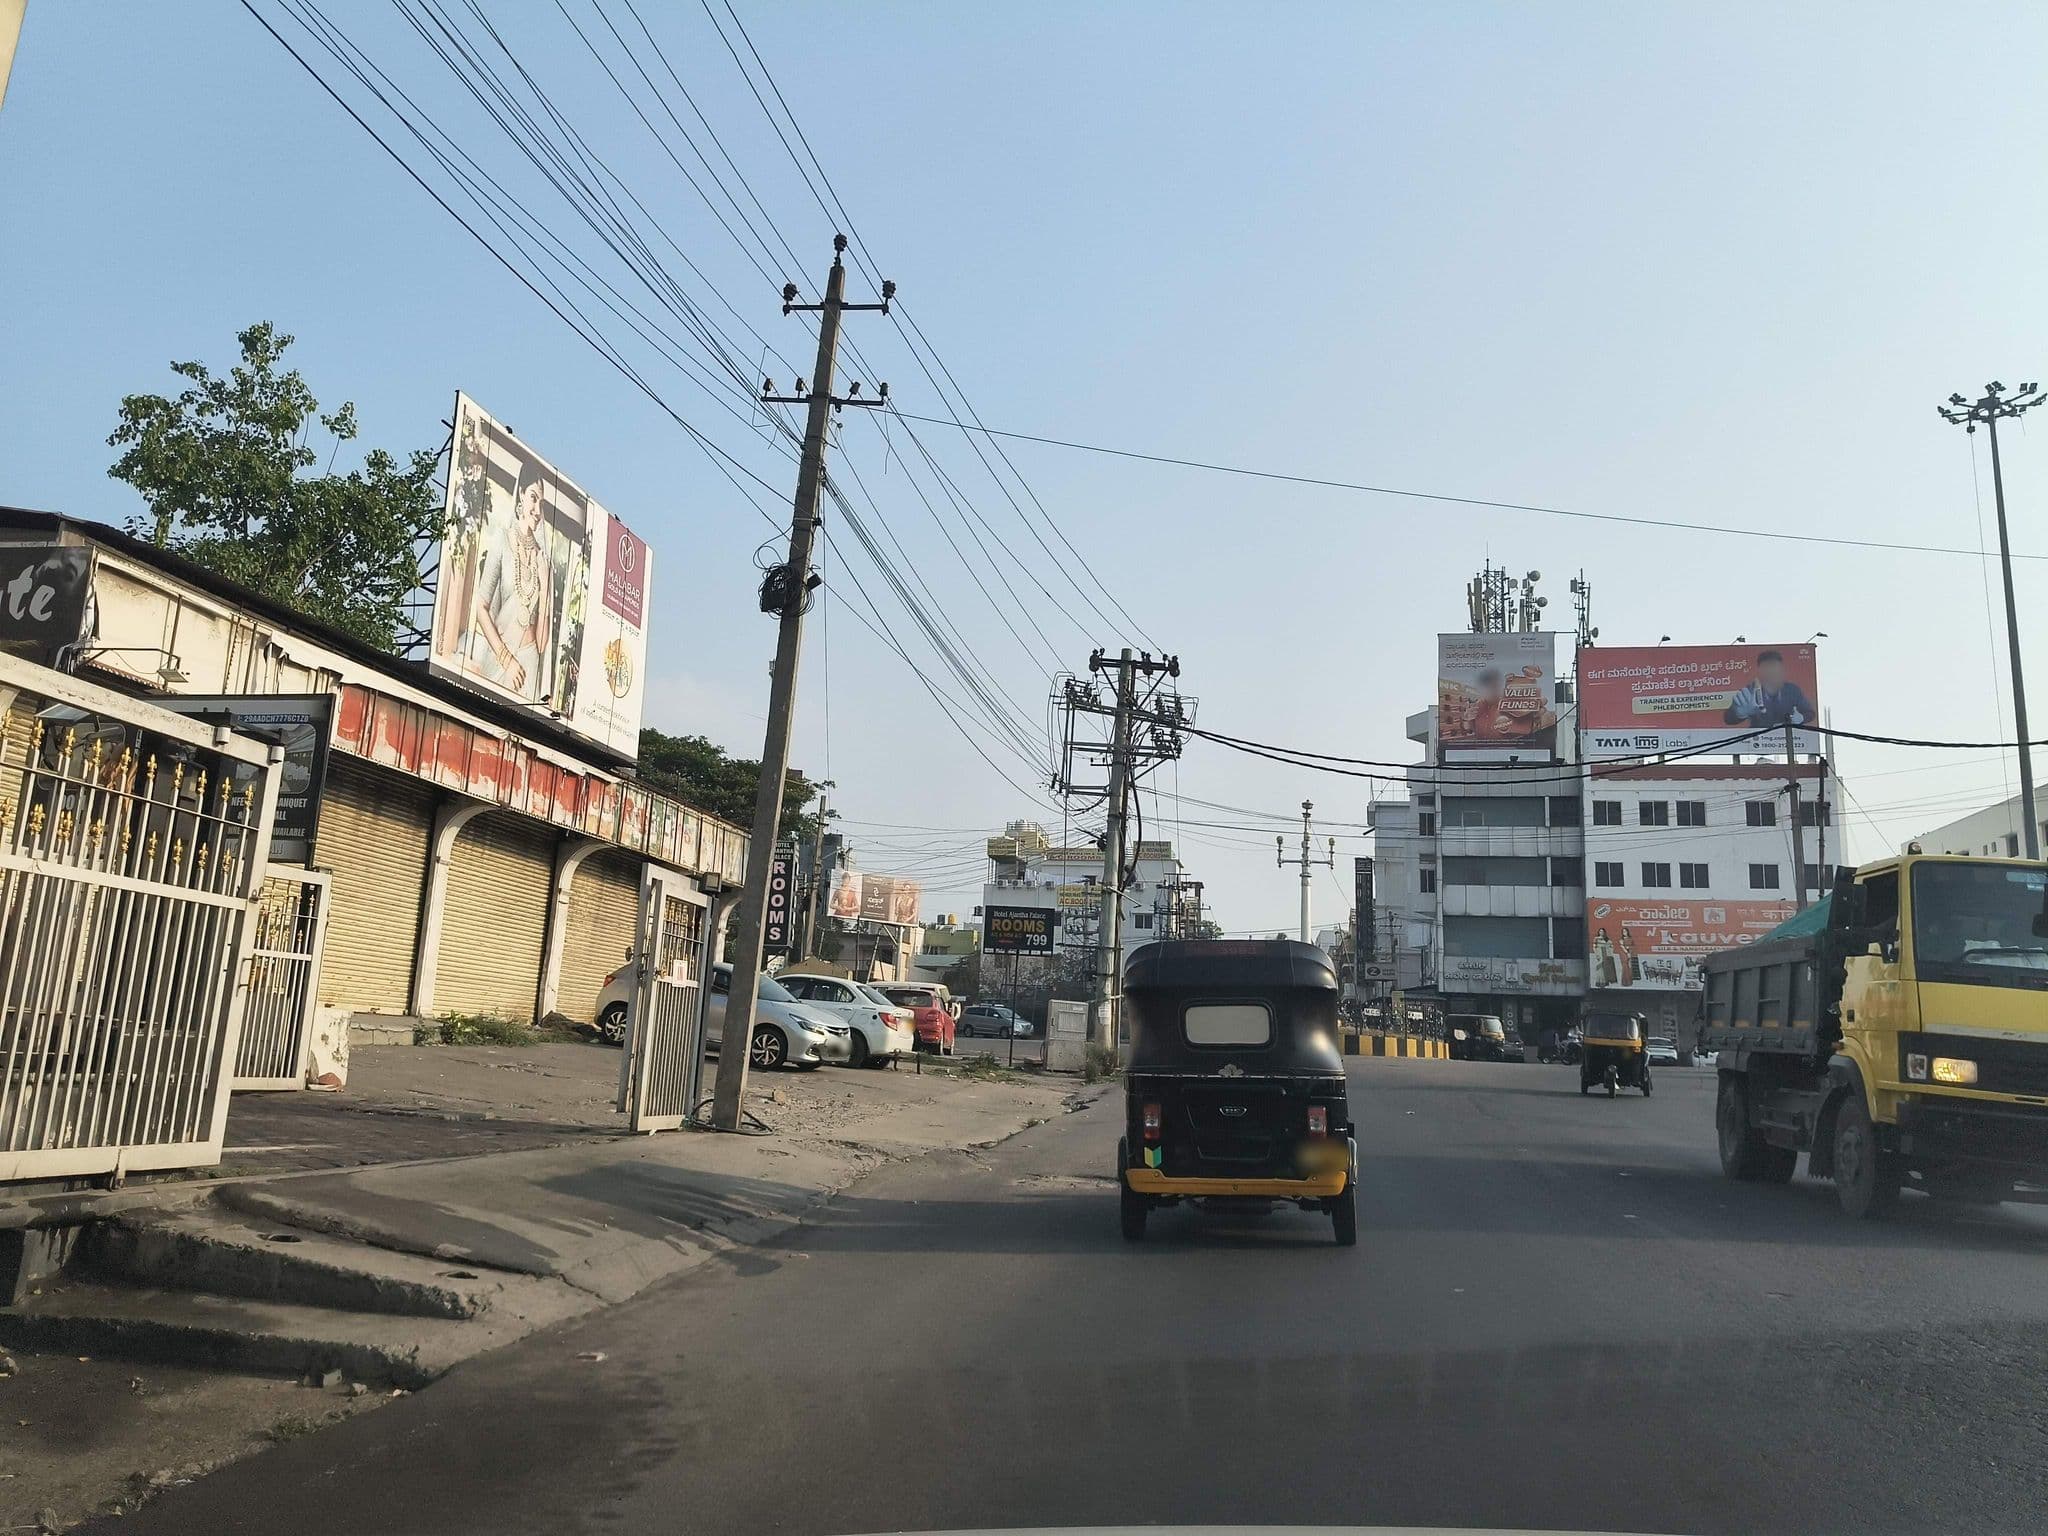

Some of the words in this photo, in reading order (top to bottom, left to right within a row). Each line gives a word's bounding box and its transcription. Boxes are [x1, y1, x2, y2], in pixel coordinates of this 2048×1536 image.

[607, 568, 641, 601] MALABAR
[0, 565, 55, 621] te
[1504, 688, 1537, 697] VALUE
[1677, 694, 1723, 703] EXPERIENCED
[1653, 702, 1710, 711] PHLEBOTOMISTS
[1595, 738, 1630, 747] TATA
[1632, 736, 1659, 749] 1mg
[1665, 738, 1688, 747] Labs
[278, 797, 308, 808] ANQUET
[768, 861, 786, 940] ROOMS
[1639, 904, 1690, 919] ಕಾವೇರಿ
[991, 918, 1046, 933] ROOMS
[1025, 934, 1048, 946] 799
